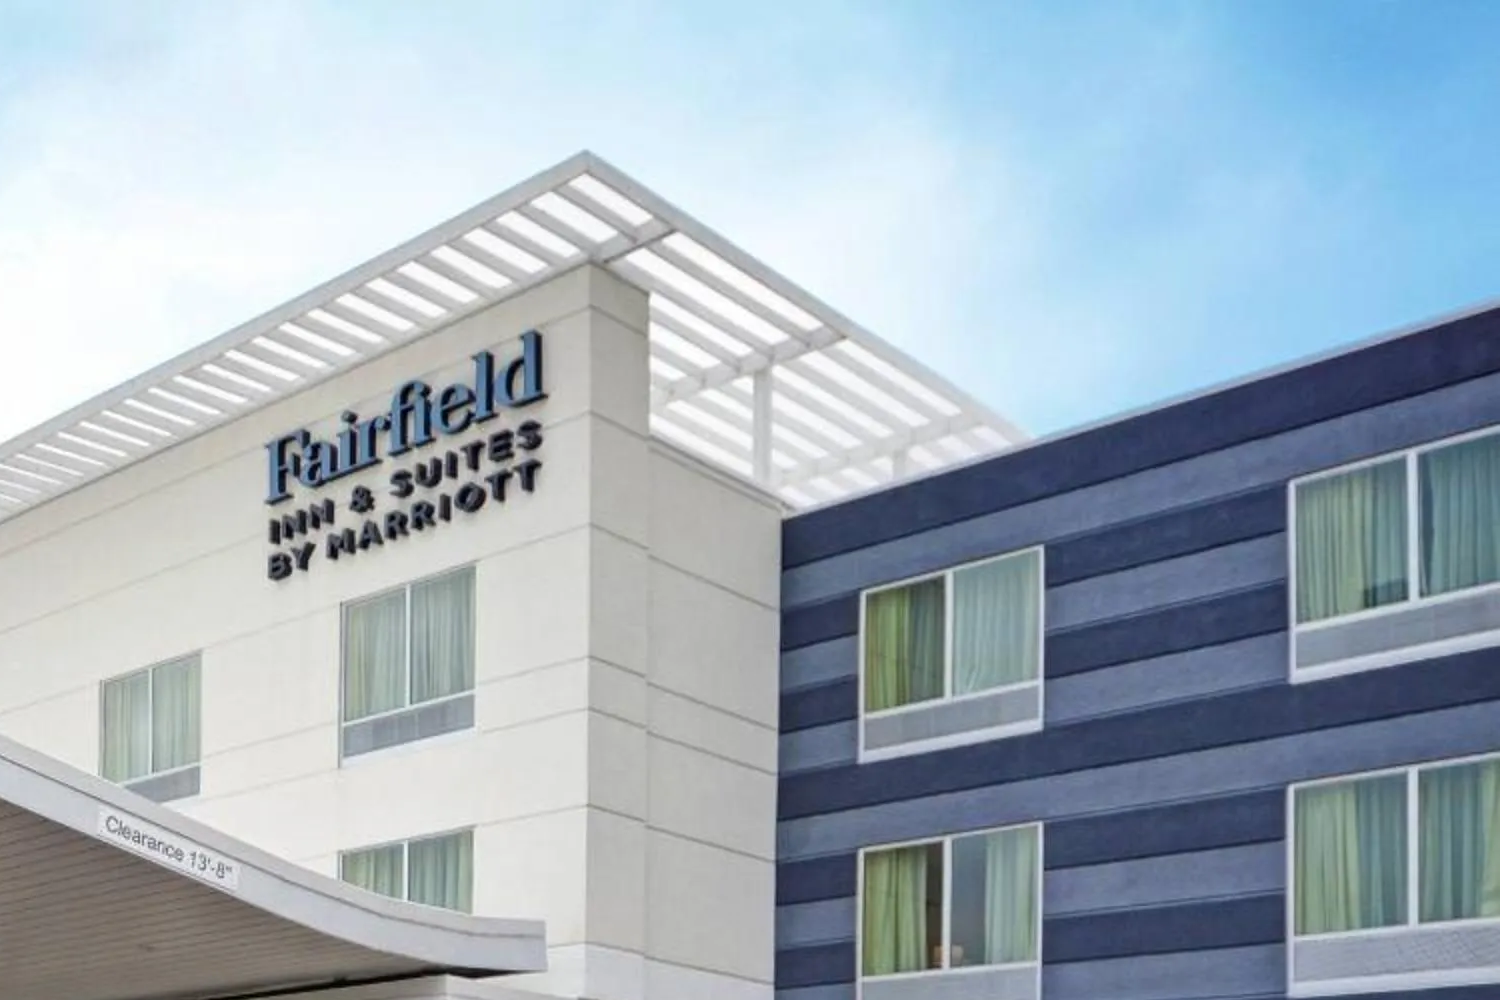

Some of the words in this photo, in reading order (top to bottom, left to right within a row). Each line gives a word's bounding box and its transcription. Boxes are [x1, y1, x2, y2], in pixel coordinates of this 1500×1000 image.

[264, 329, 548, 505] Fairfield
[268, 542, 316, 581] BY
[326, 459, 542, 560] MARRIOTT
[269, 498, 335, 544] INN
[350, 485, 375, 513] &
[390, 420, 543, 498] SUITES
[105, 815, 185, 862] Clearance
